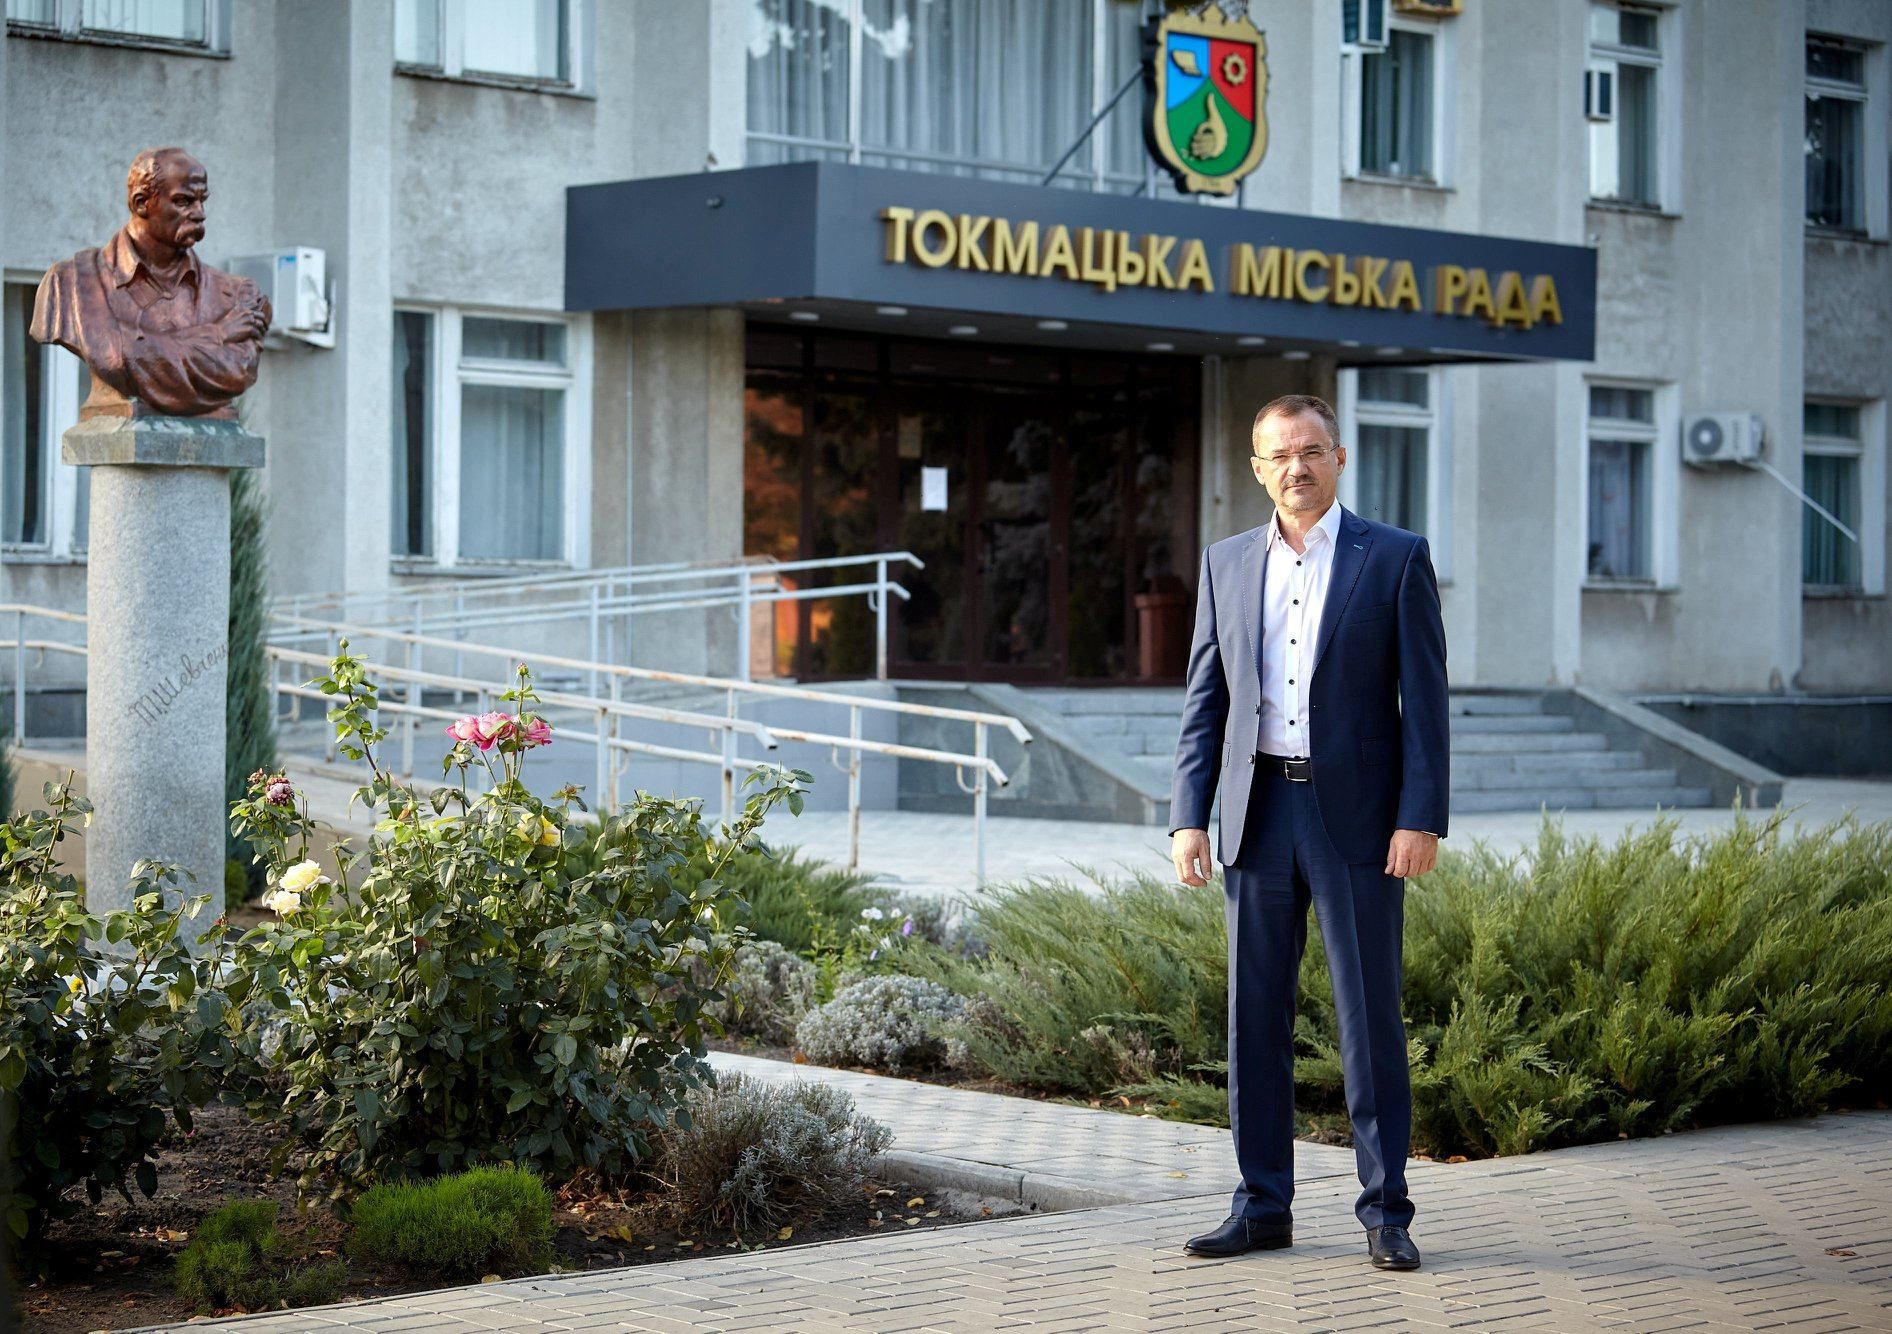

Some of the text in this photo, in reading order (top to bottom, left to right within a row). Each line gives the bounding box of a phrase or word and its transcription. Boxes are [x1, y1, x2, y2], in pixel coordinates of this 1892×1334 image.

[882, 206, 1562, 329] ТОКМАЦЬКА МІСЬКА РАДА
